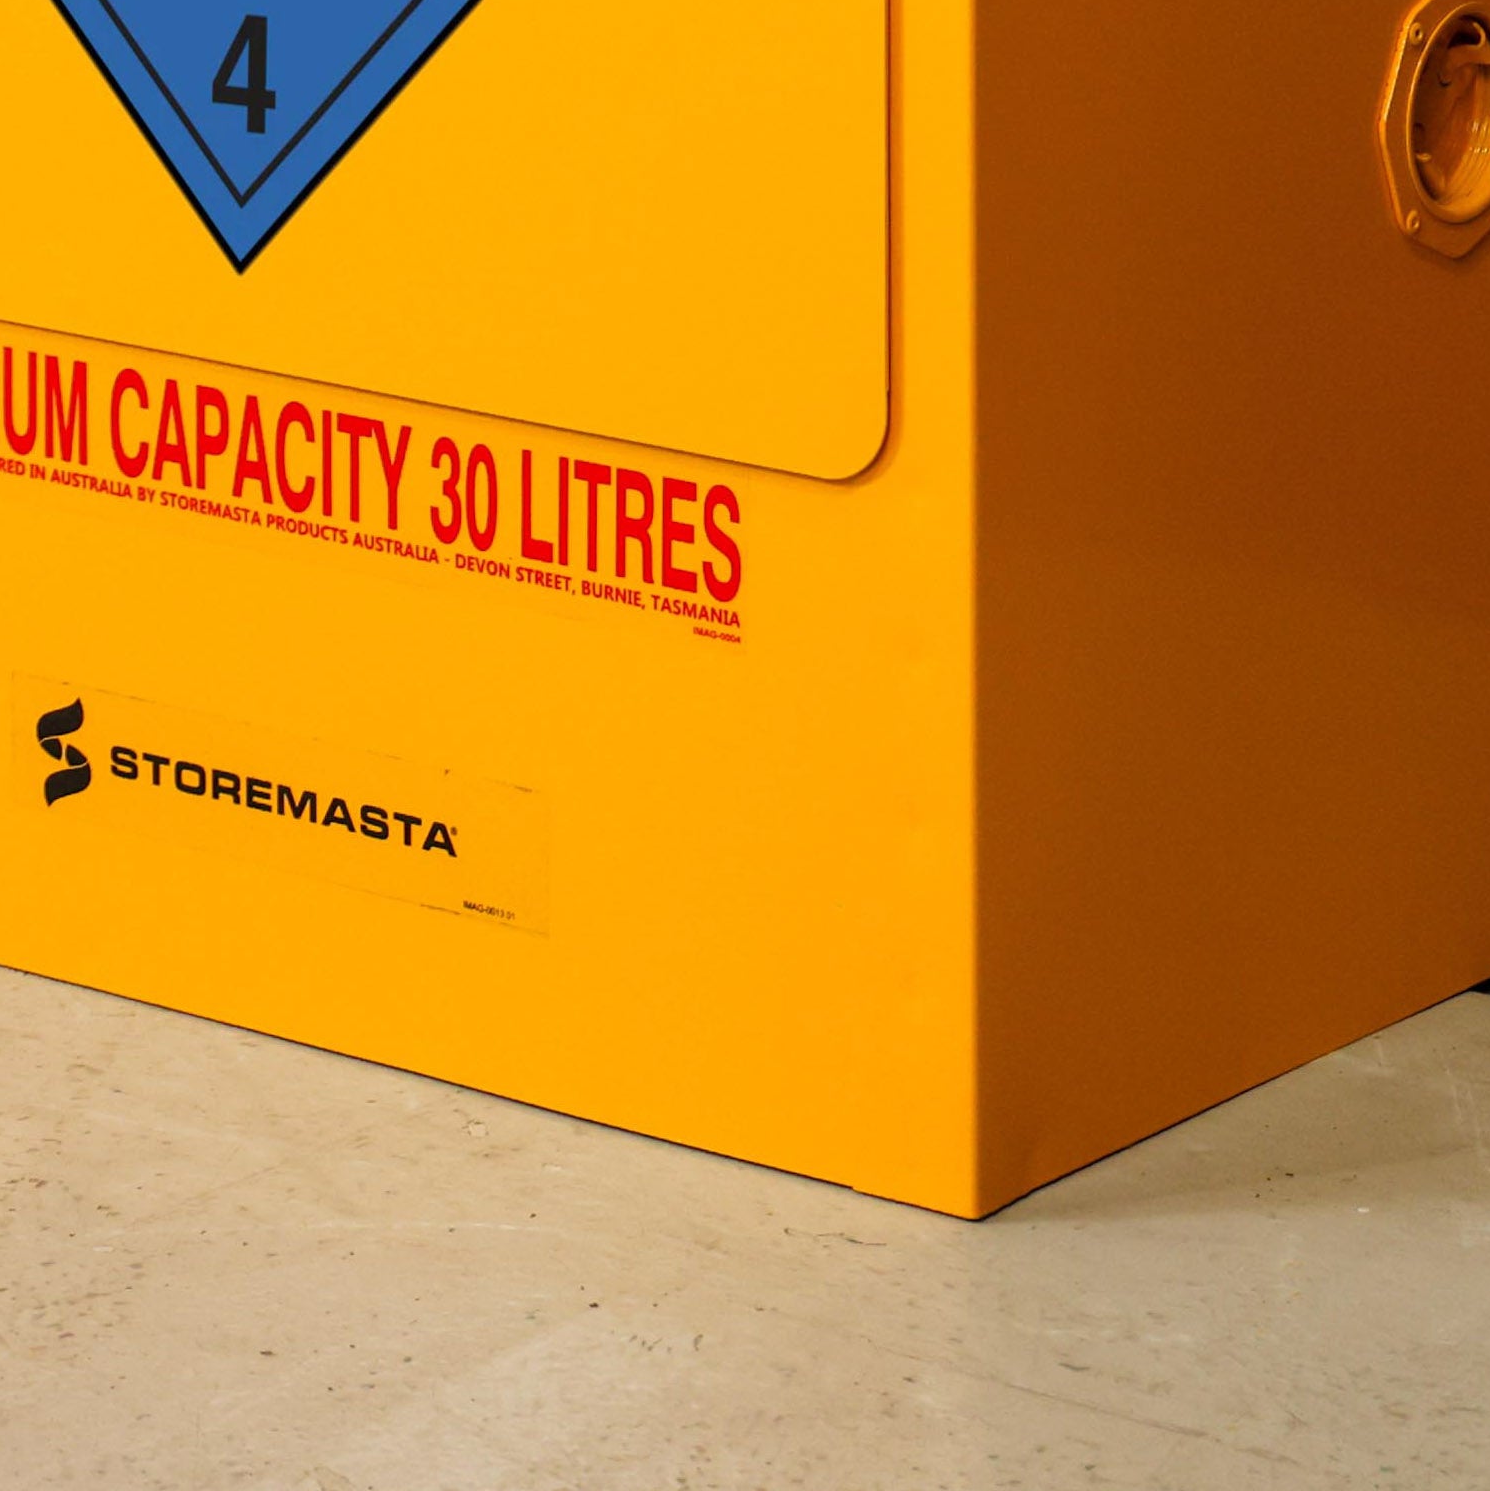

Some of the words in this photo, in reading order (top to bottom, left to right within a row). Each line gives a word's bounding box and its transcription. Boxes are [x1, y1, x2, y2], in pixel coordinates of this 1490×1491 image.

[211, 14, 277, 135] 4
[29, 464, 46, 481] IN
[50, 468, 133, 499] AUSTRALIA
[137, 486, 156, 503] BY
[159, 491, 262, 527] STOREMASTA
[266, 513, 348, 544] PRODUCTS
[352, 533, 440, 564] AUSTRALIA
[454, 554, 510, 579] DEVON
[515, 566, 576, 596] STREET,
[581, 580, 646, 610] BURNIE,
[650, 594, 741, 628] TASMANIA
[110, 368, 412, 530] CAPACITY
[430, 436, 498, 552] 30
[521, 449, 742, 603] LITRES
